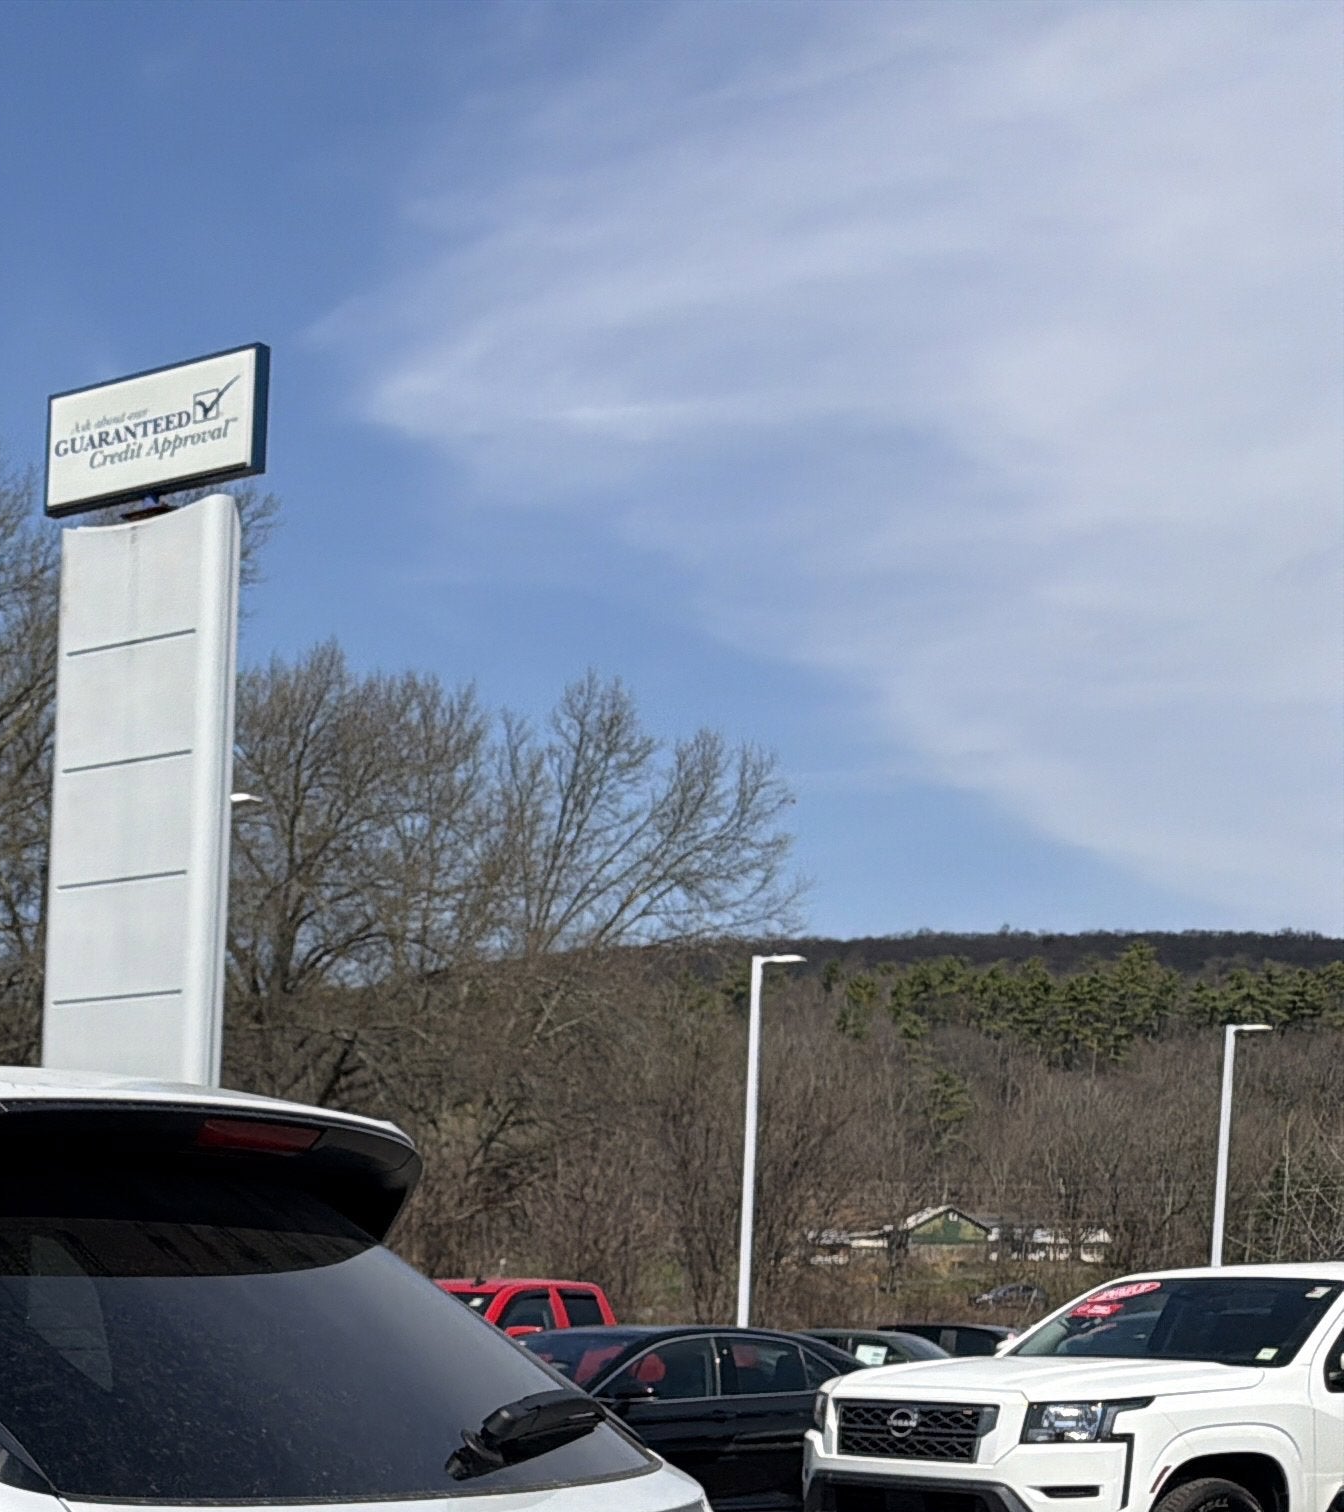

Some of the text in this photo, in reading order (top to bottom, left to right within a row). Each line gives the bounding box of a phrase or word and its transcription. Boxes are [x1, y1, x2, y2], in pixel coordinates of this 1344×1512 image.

[55, 410, 191, 457] GUARANTEED
[89, 416, 238, 469] Credit Approval
